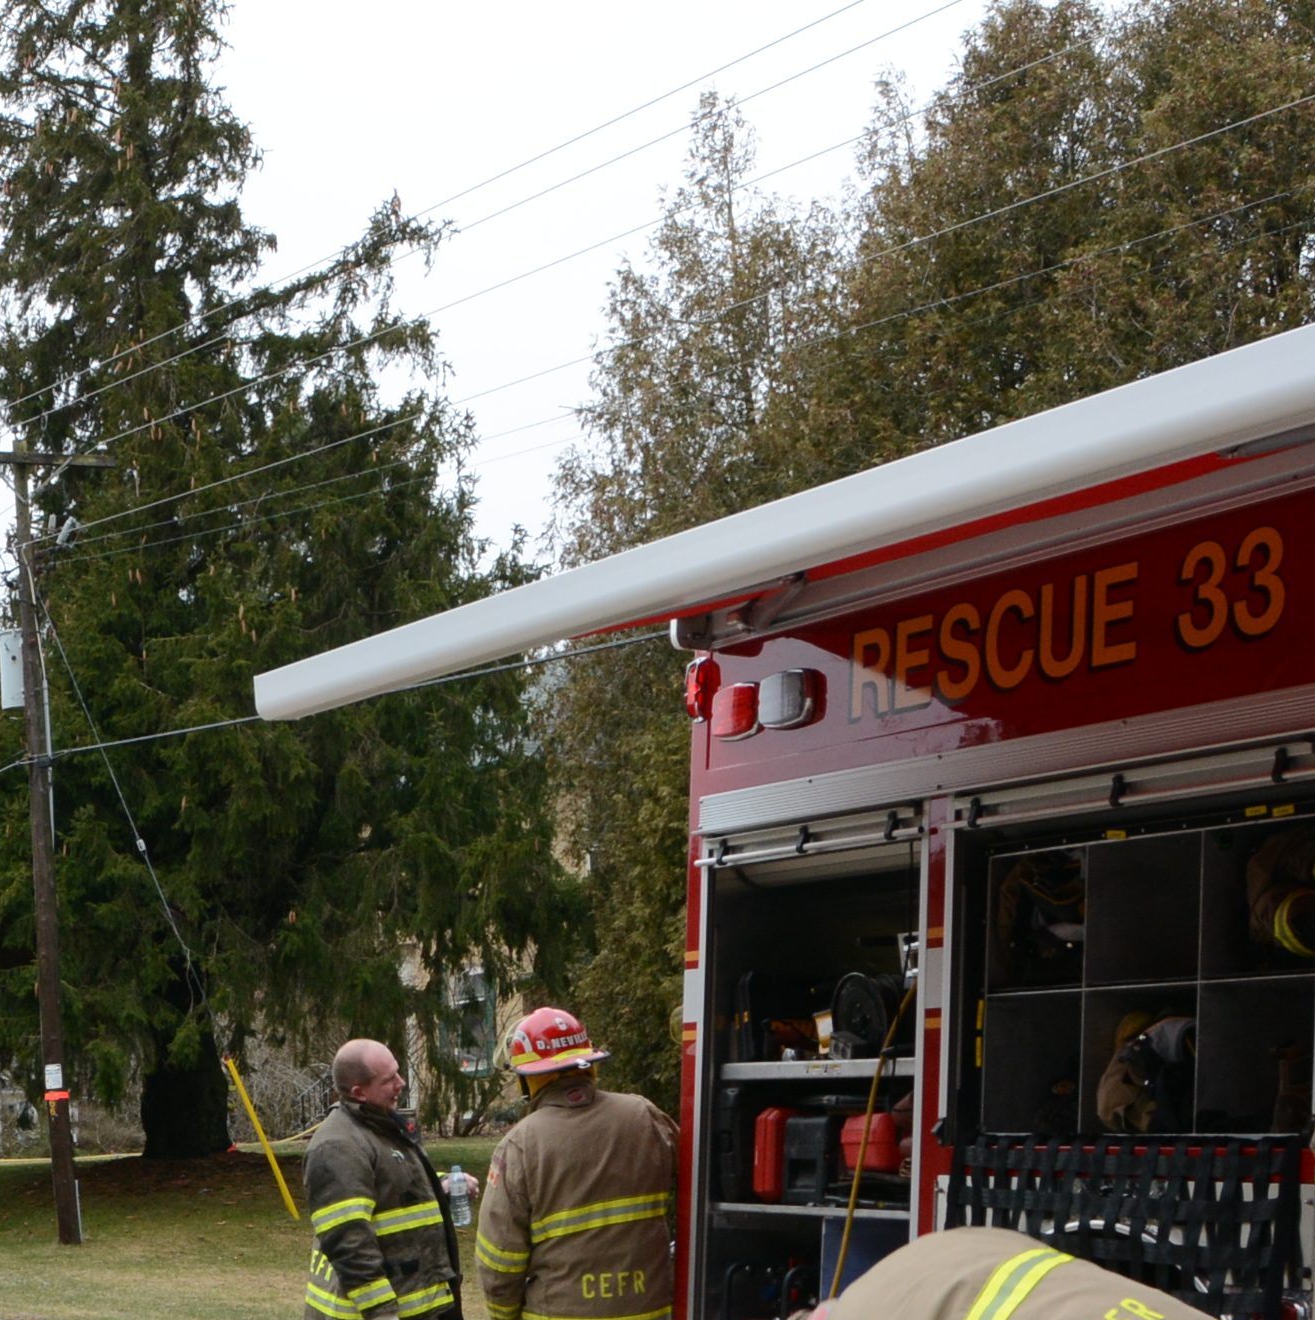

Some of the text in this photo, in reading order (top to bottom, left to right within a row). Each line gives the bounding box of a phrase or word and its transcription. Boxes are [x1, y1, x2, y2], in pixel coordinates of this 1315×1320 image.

[849, 526, 1286, 720] RESCUE 33
[581, 1270, 646, 1299] CEFR
